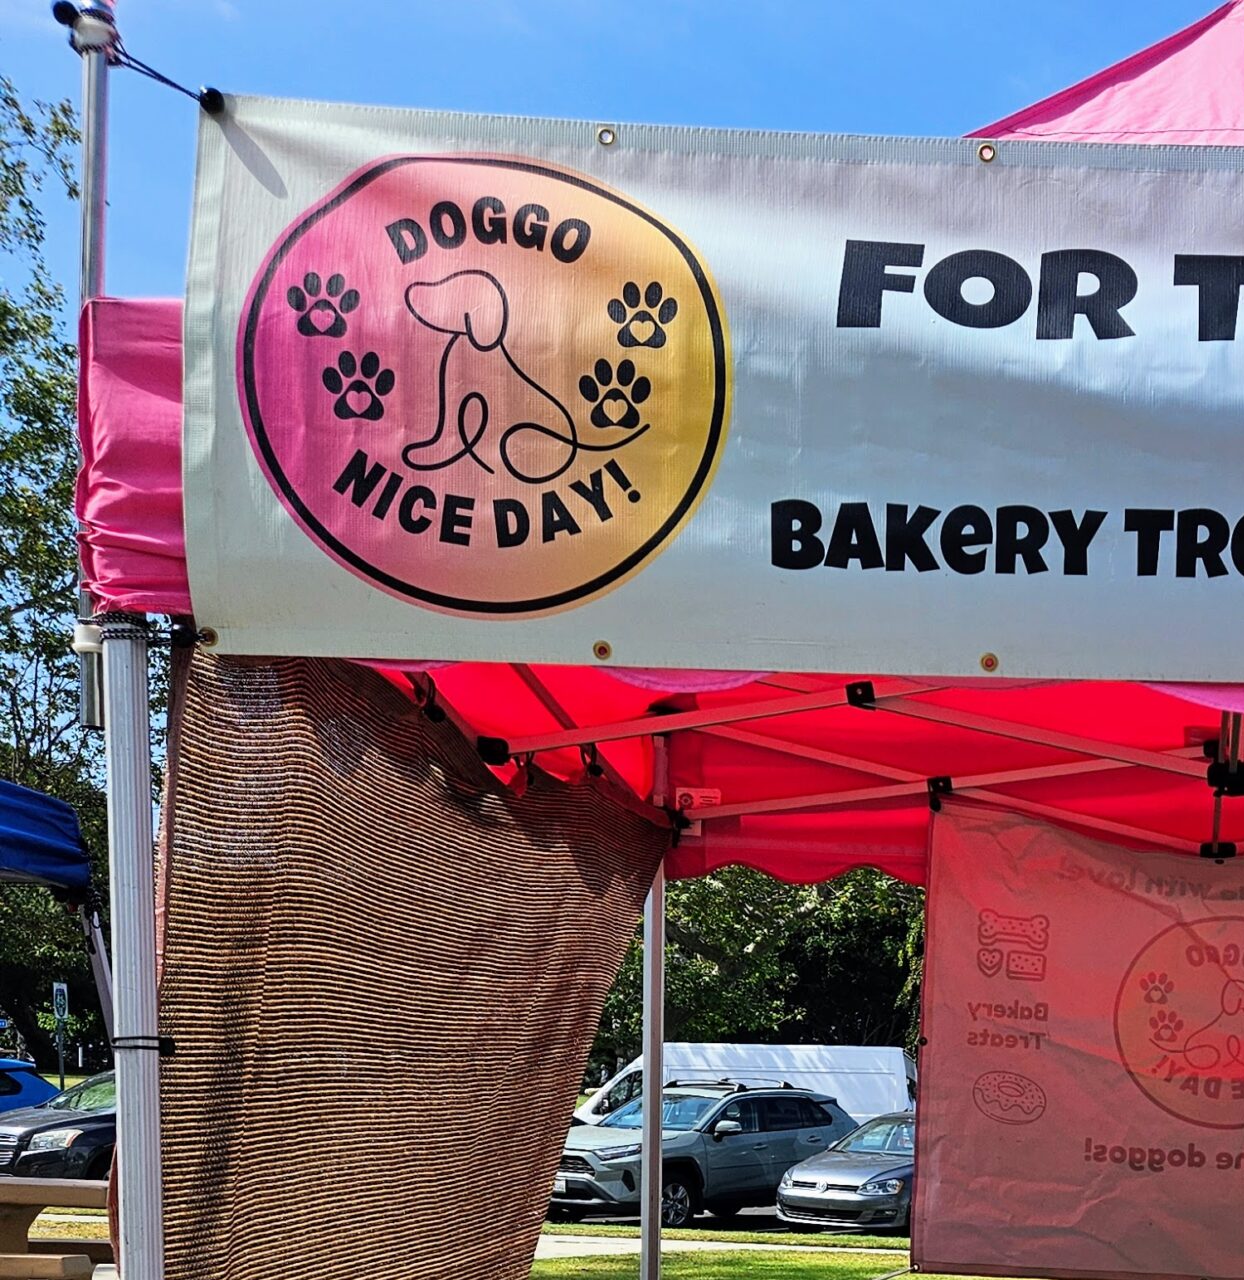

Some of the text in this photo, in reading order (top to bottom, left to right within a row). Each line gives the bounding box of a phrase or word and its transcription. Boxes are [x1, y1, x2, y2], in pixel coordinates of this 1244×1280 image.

[385, 196, 592, 265] DOGGO
[836, 239, 1138, 341] FOR
[332, 448, 641, 548] NICE DAY!
